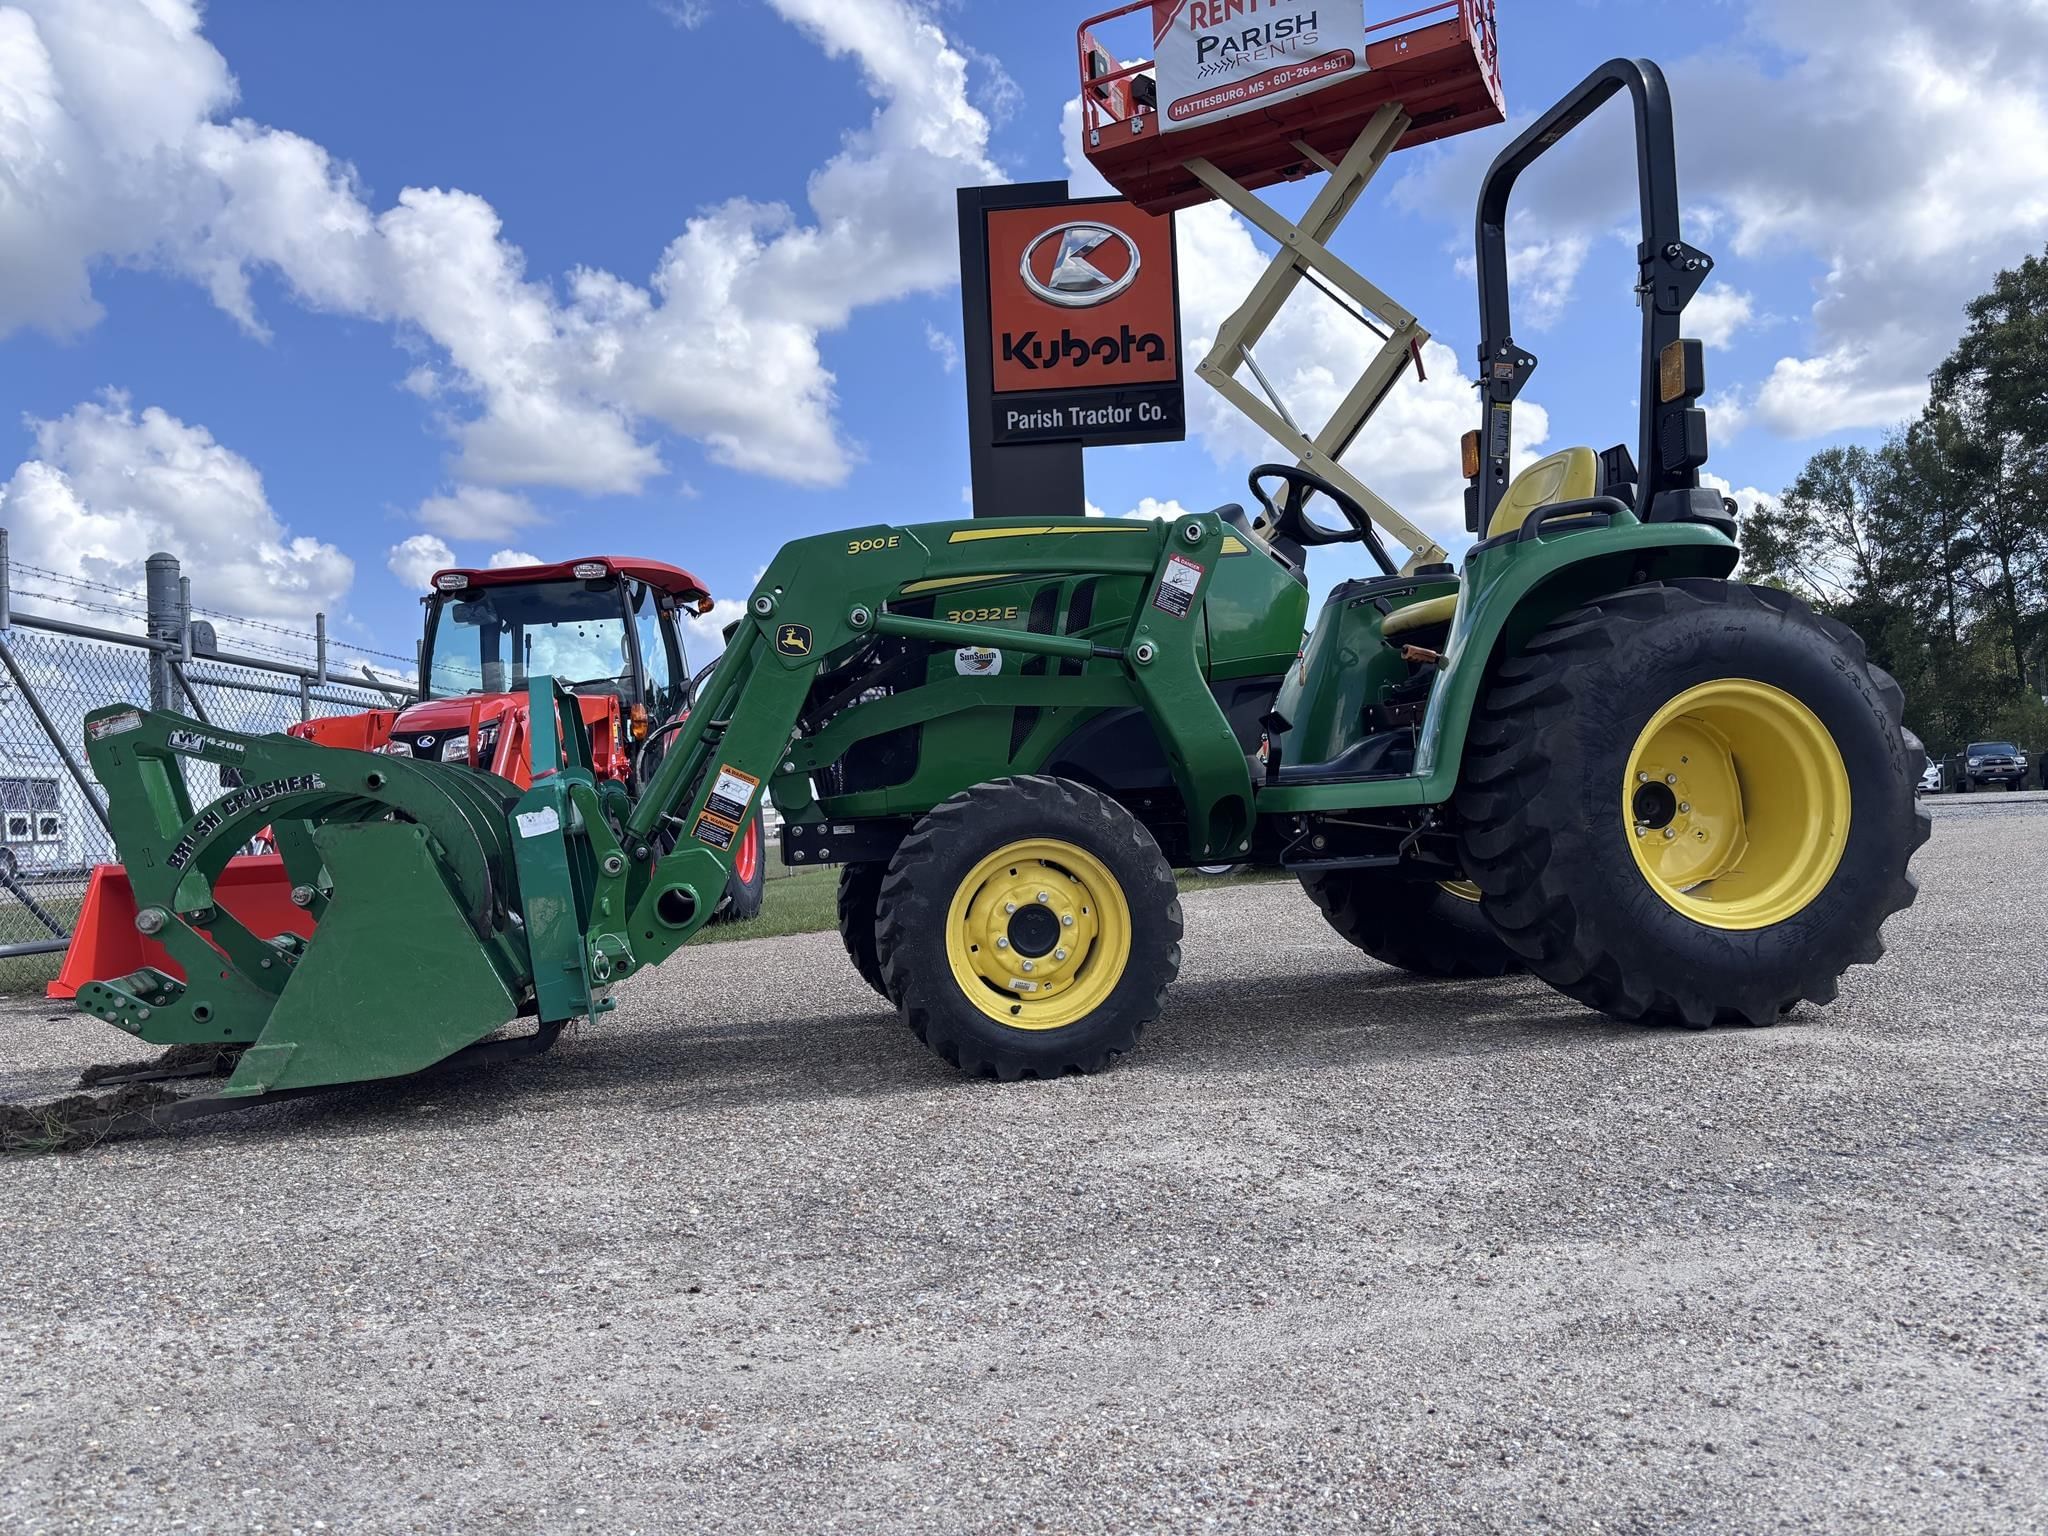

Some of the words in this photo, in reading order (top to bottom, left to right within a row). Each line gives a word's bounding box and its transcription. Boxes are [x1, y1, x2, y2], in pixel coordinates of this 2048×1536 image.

[1196, 10, 1318, 65] PARISH
[1234, 31, 1319, 67] RENTS
[1248, 80, 1266, 96] MS
[1273, 55, 1347, 86] 601-264-5877
[1002, 325, 1165, 370] Kubota
[1007, 409, 1063, 430] Parish
[1069, 404, 1132, 426] Tractor
[1138, 402, 1167, 421] Co.
[1180, 559, 1200, 571] DANGER
[959, 651, 997, 661] SunSouth
[206, 737, 246, 752] 4200
[731, 769, 755, 783] WARNING
[221, 773, 314, 817] CRUSHER
[709, 817, 734, 831] WARNING
